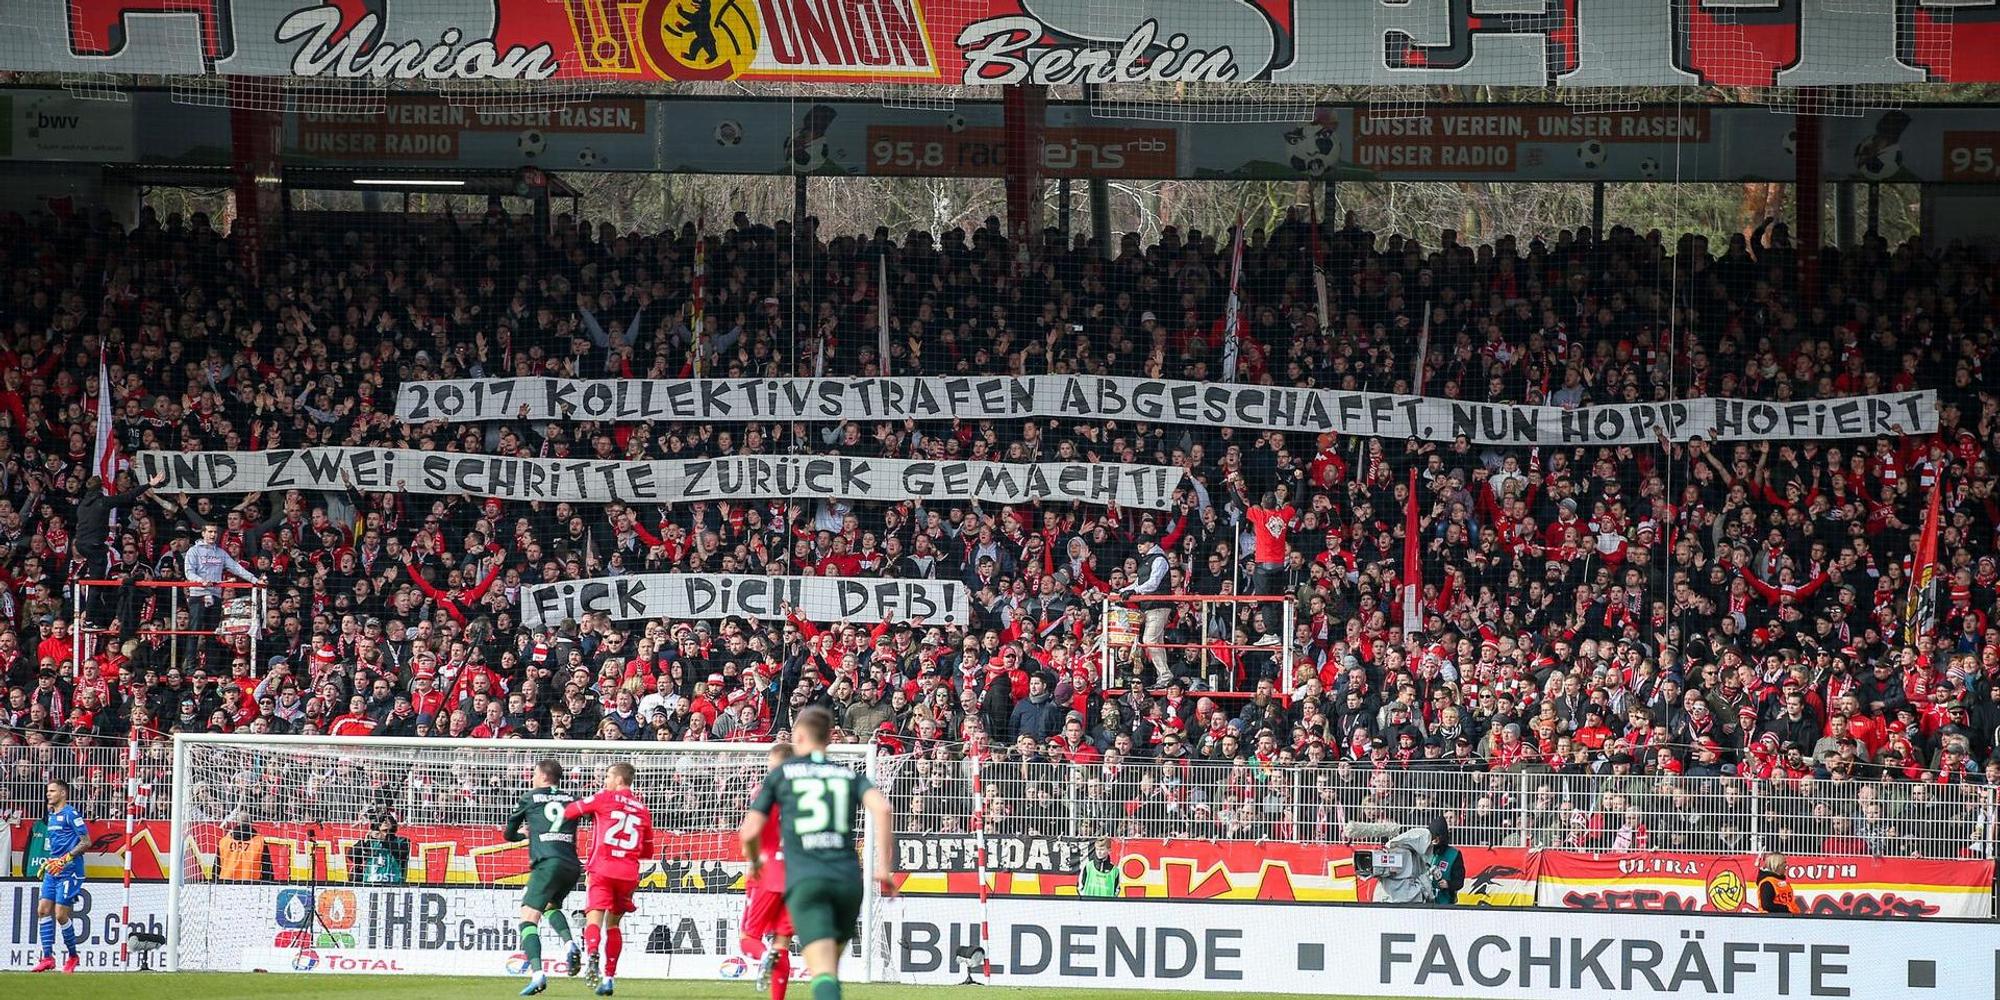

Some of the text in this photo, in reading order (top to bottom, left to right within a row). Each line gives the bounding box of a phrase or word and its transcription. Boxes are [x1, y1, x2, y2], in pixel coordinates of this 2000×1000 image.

[276, 4, 559, 81] Union
[954, 16, 1240, 86] Berlin
[37, 111, 79, 129] bwv
[385, 105, 470, 128] VEREIN,
[559, 107, 638, 131] RASEN,
[1360, 116, 1702, 140] UNSER VEREIN, UNSER RASEN,
[304, 133, 451, 154] UNSER RADIO
[872, 141, 944, 171] 95,8
[1360, 147, 1433, 165] UNSER
[1441, 147, 1510, 166] RADIO
[408, 380, 516, 419] 2017
[1060, 377, 1434, 439] ABGESCHAFFT,
[1451, 404, 1538, 442] NUN
[1561, 402, 1688, 442] HOPP
[143, 452, 237, 489] UND
[683, 456, 872, 496] ZURÜCK
[902, 462, 1169, 507] GEMACHT!
[836, 579, 956, 623] DFB!
[543, 801, 565, 832] 9
[791, 777, 851, 836] 31
[604, 810, 642, 850] 25
[1786, 864, 1858, 880] OUTH
[326, 955, 404, 971] TOTAL
[901, 921, 1243, 980] BILDENDE
[1379, 929, 1851, 997] FACHKRÄFTE
